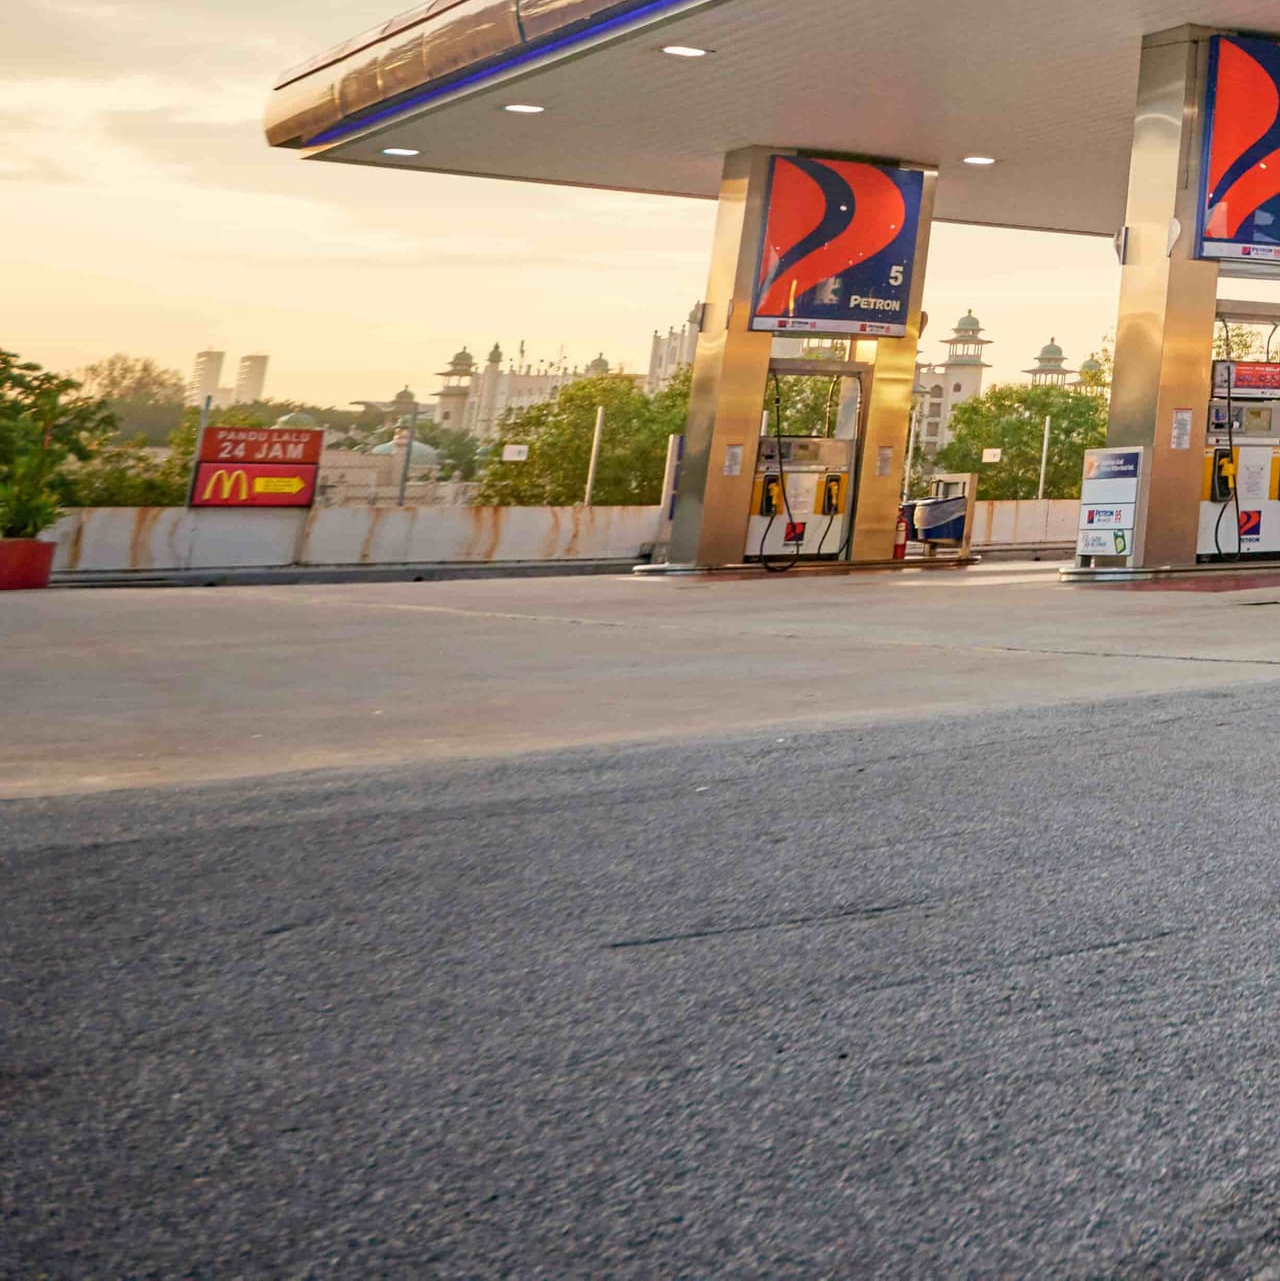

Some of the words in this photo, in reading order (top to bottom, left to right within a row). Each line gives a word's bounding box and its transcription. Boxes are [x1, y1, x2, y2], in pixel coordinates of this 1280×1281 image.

[888, 265, 904, 286] 5
[850, 295, 901, 312] PETRON
[218, 442, 246, 459] 24
[255, 443, 305, 460] JAM
